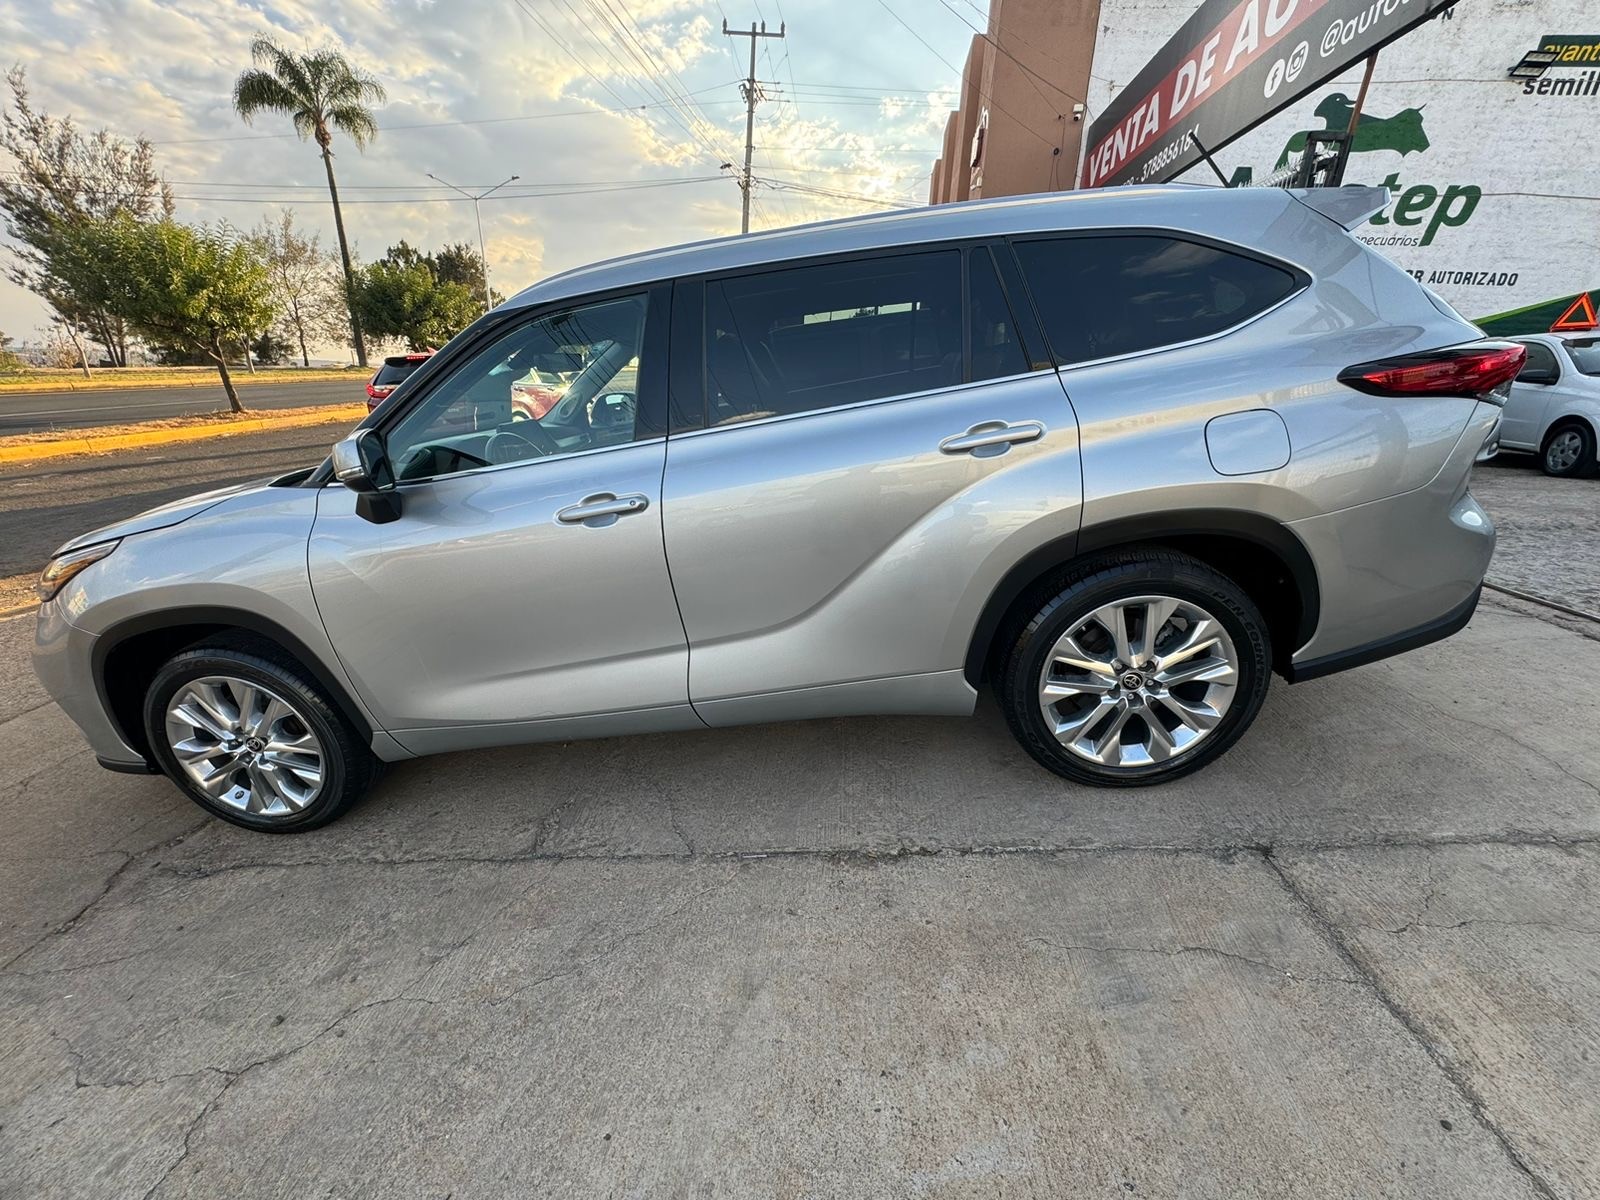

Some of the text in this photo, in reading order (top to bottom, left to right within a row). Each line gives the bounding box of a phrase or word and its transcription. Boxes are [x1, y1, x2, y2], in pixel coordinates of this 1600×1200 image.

[1319, 0, 1411, 57] @auto
[1090, 0, 1314, 187] VENTA DE AU
[1355, 232, 1419, 247] ecuários
[1427, 270, 1519, 287] AUTORIZADO
